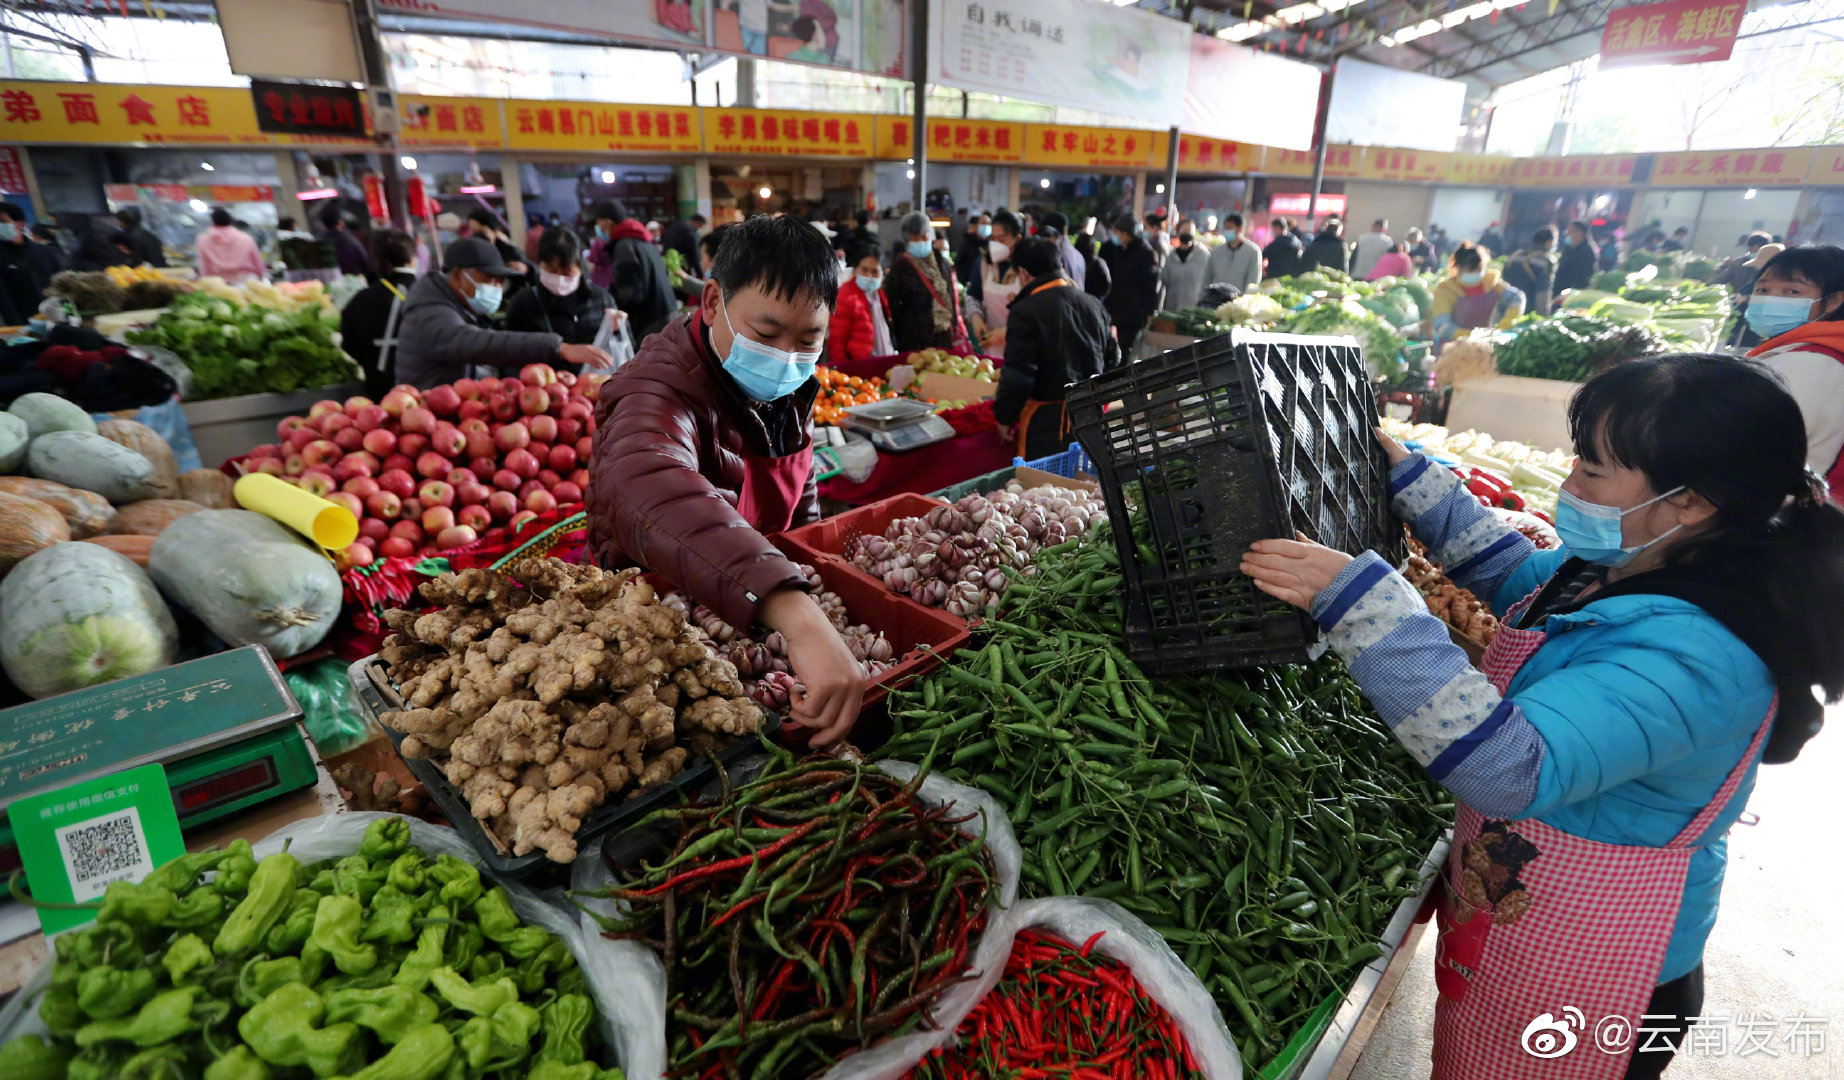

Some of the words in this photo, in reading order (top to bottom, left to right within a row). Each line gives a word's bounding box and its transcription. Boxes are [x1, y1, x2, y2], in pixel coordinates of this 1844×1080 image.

[892, 121, 1011, 150] 喜粑粑米糕
[40, 783, 140, 820] 推荐使用微信支付
